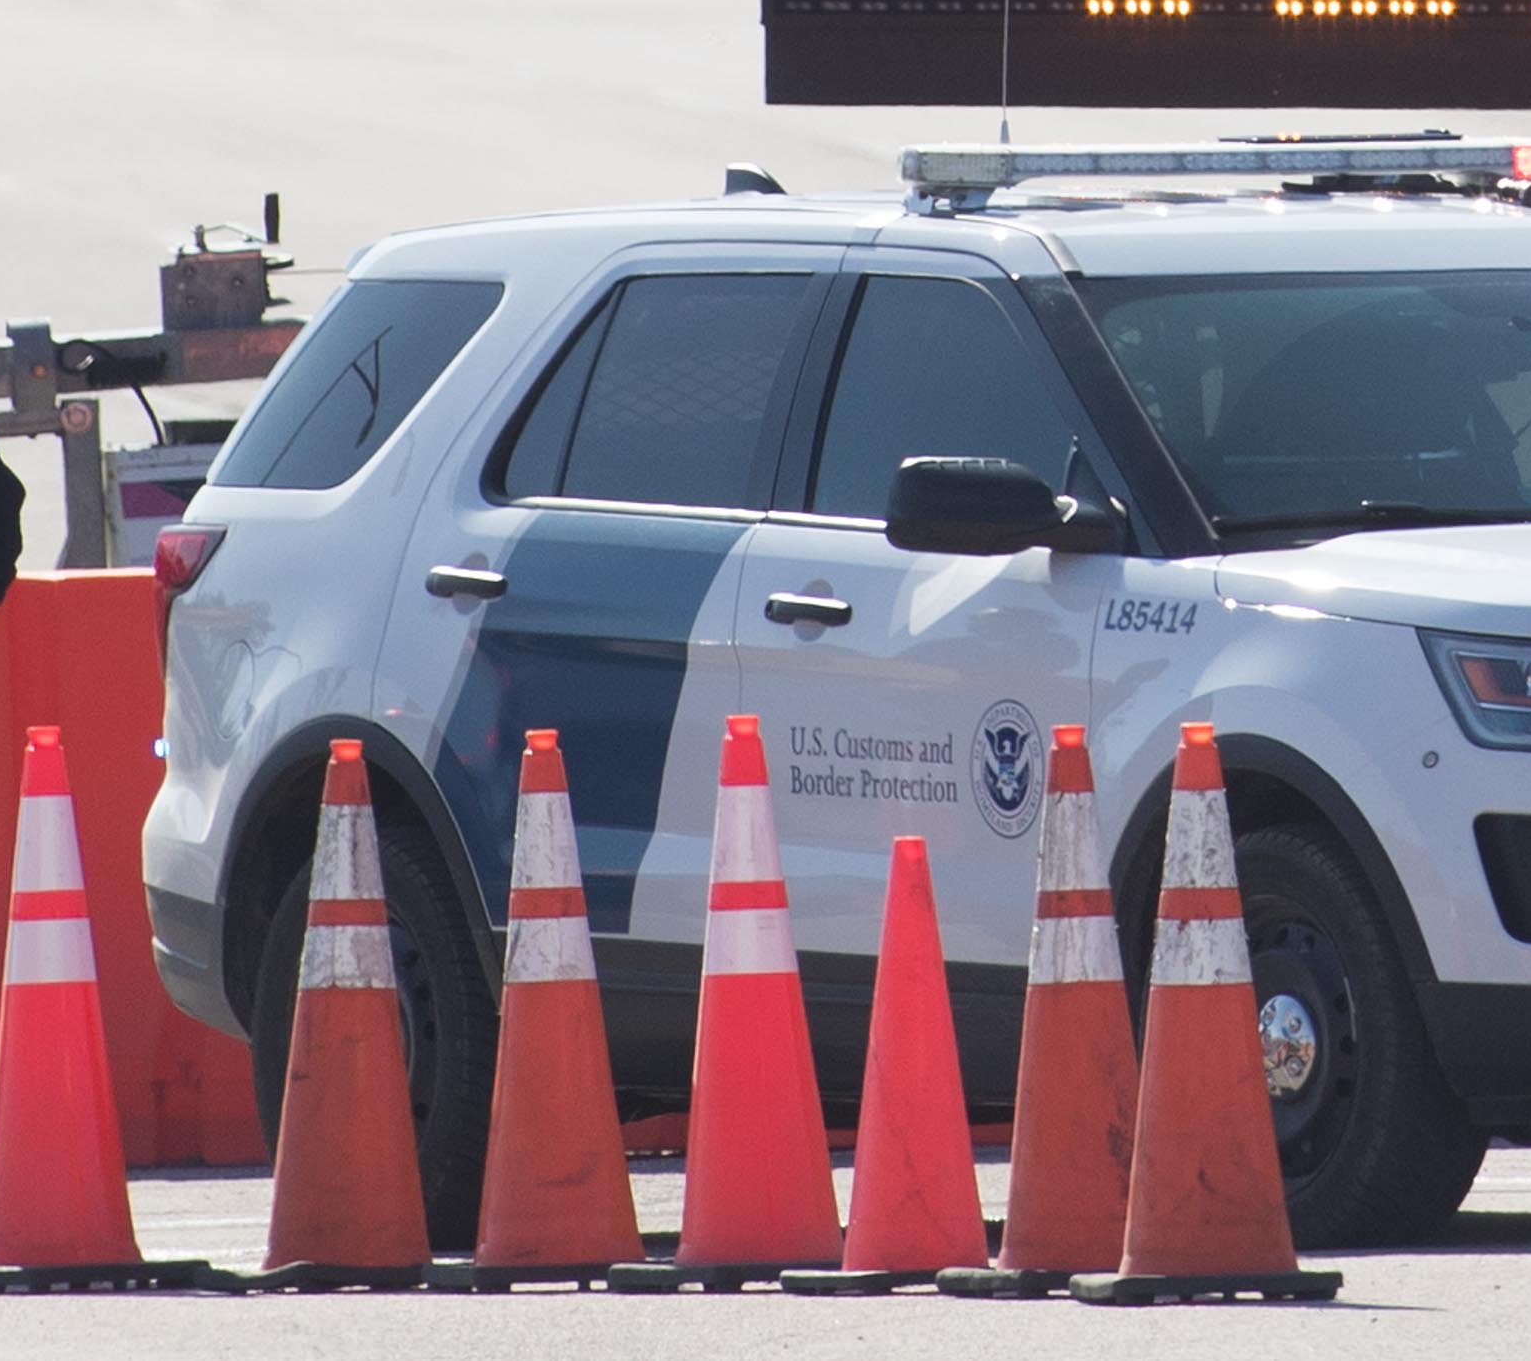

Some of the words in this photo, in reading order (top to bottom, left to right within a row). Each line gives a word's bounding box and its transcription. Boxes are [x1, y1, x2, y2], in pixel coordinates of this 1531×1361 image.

[1104, 598, 1197, 633] L85414
[790, 726, 828, 757] U.S.
[834, 728, 913, 762] Customs
[919, 732, 953, 765] and
[790, 765, 855, 797] Border
[860, 769, 959, 803] Protection
